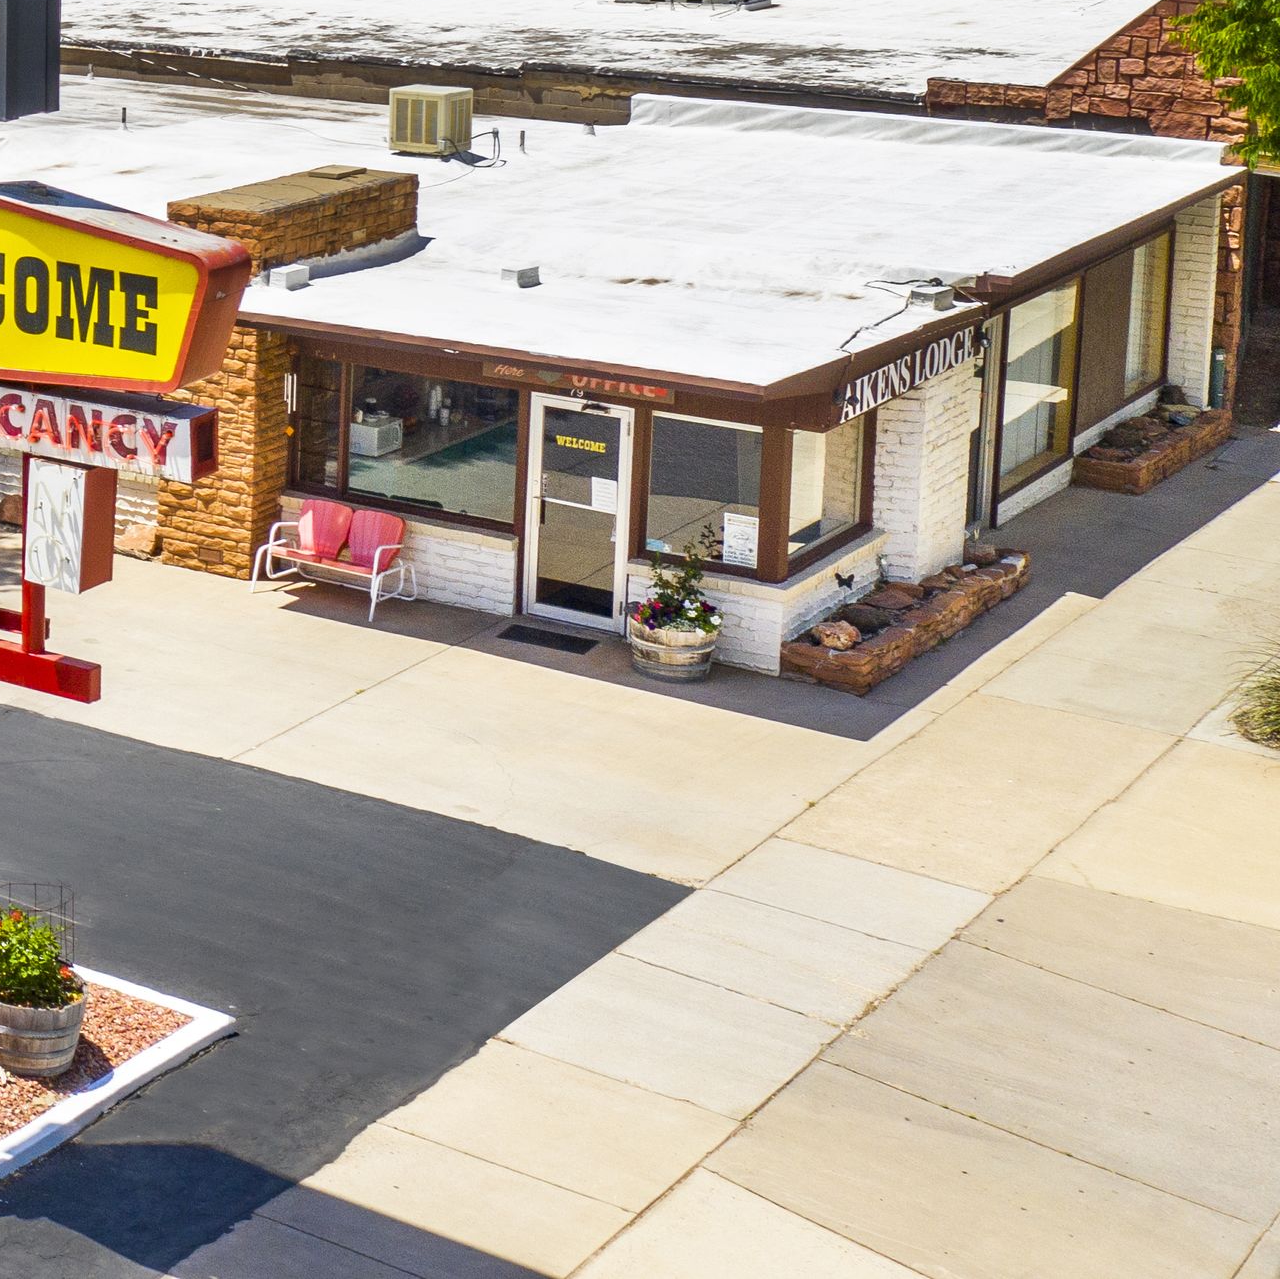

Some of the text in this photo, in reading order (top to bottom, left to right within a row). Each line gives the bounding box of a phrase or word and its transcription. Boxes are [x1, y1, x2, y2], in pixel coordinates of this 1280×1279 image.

[495, 363, 525, 378] Here
[840, 325, 975, 425] AIKENS LODGE
[555, 434, 607, 454] WELCOME
